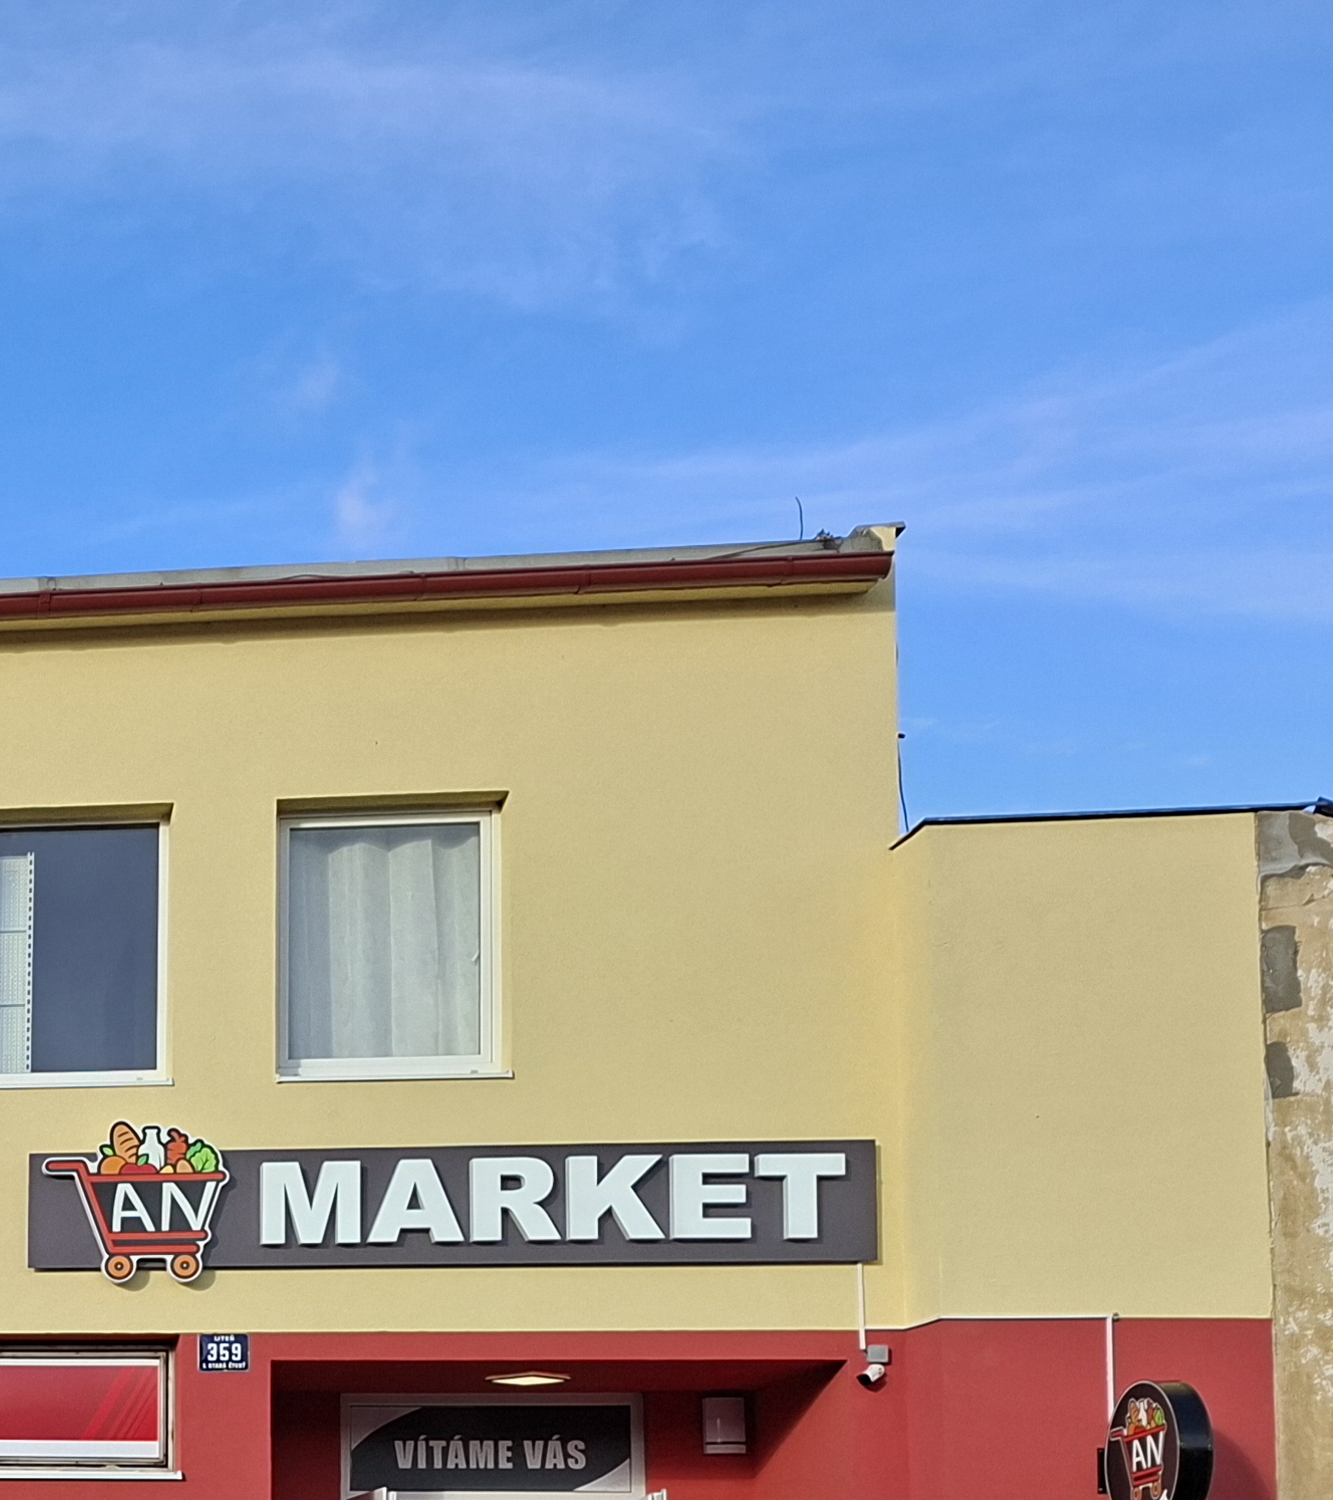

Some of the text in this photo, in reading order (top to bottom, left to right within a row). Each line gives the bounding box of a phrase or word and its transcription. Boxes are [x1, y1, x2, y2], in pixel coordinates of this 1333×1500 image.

[112, 1180, 217, 1233] AN
[259, 1152, 846, 1246] MARKET
[207, 1343, 242, 1361] 359
[394, 1434, 587, 1469] VÍTÁME VÁS
[1133, 1430, 1164, 1471] AN
